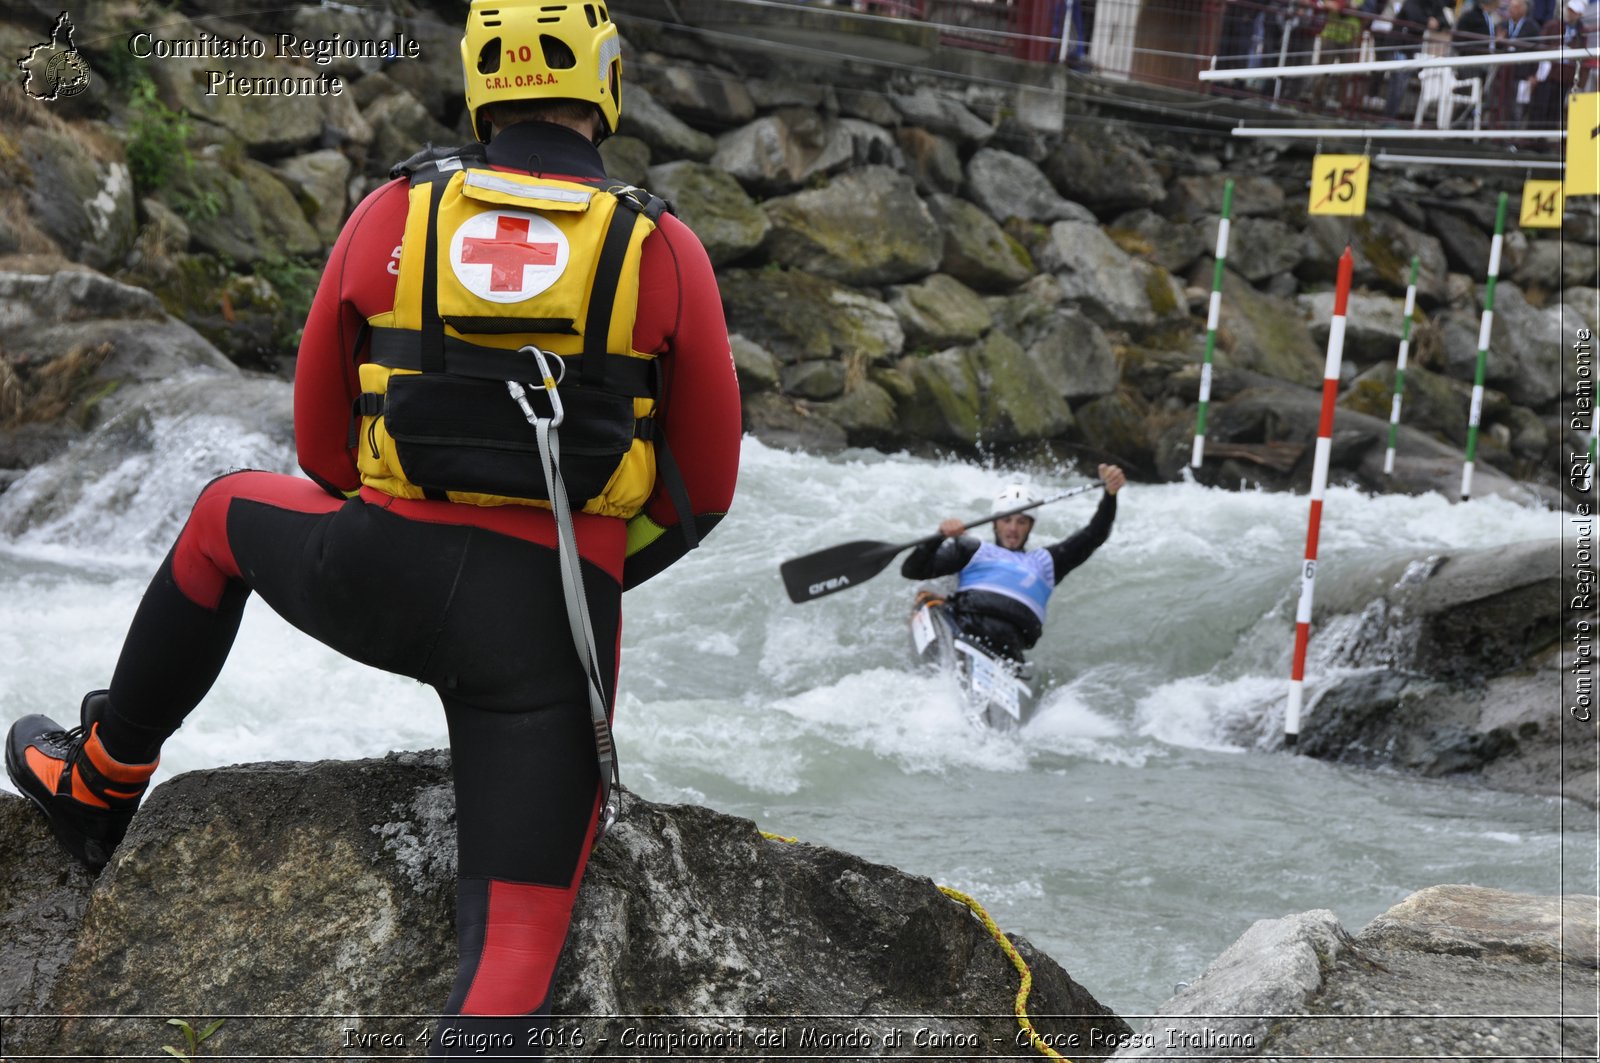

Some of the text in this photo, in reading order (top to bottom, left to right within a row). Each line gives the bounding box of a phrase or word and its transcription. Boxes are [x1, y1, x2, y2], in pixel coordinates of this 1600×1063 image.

[506, 45, 532, 63] 10
[485, 72, 559, 90] C.R.I. O.P.S.A.
[1324, 168, 1355, 202] 15
[1531, 190, 1556, 217] 14
[1305, 561, 1315, 579] 6
